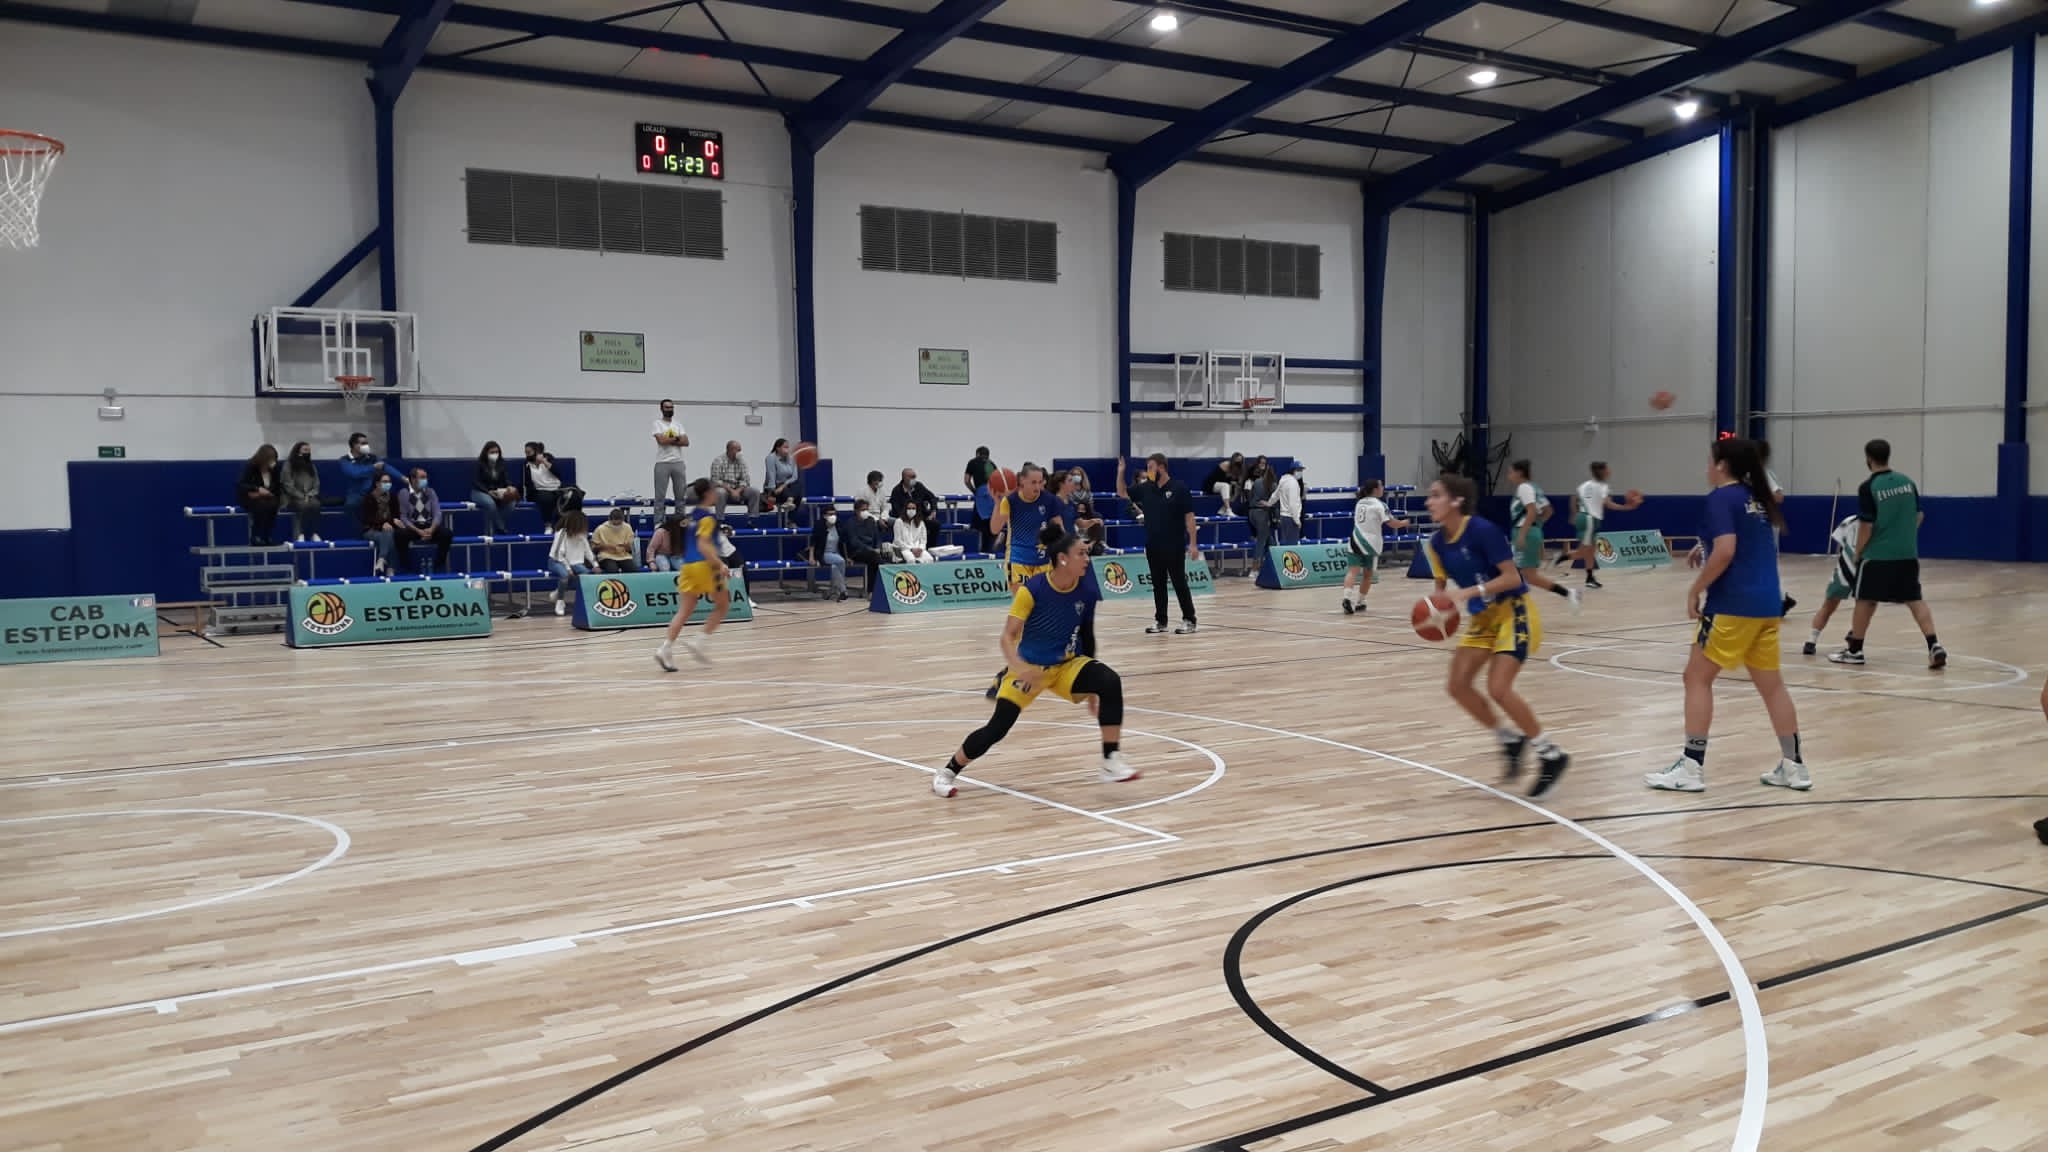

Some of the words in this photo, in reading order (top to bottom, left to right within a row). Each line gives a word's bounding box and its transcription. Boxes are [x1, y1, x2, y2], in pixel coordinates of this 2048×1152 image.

[655, 135, 665, 152] 0
[642, 154, 651, 169] 0
[663, 154, 704, 174] 15:23
[711, 162, 719, 175] 0
[1629, 535, 1648, 545] CAB
[1620, 543, 1667, 557] ESTEPONA
[954, 567, 985, 580] CAB
[1312, 560, 1347, 572] ESTEP
[400, 586, 444, 602] CAB
[51, 604, 104, 622] CAB
[363, 602, 484, 622] ESTEPONA
[4, 621, 150, 644] ESTEPONA
